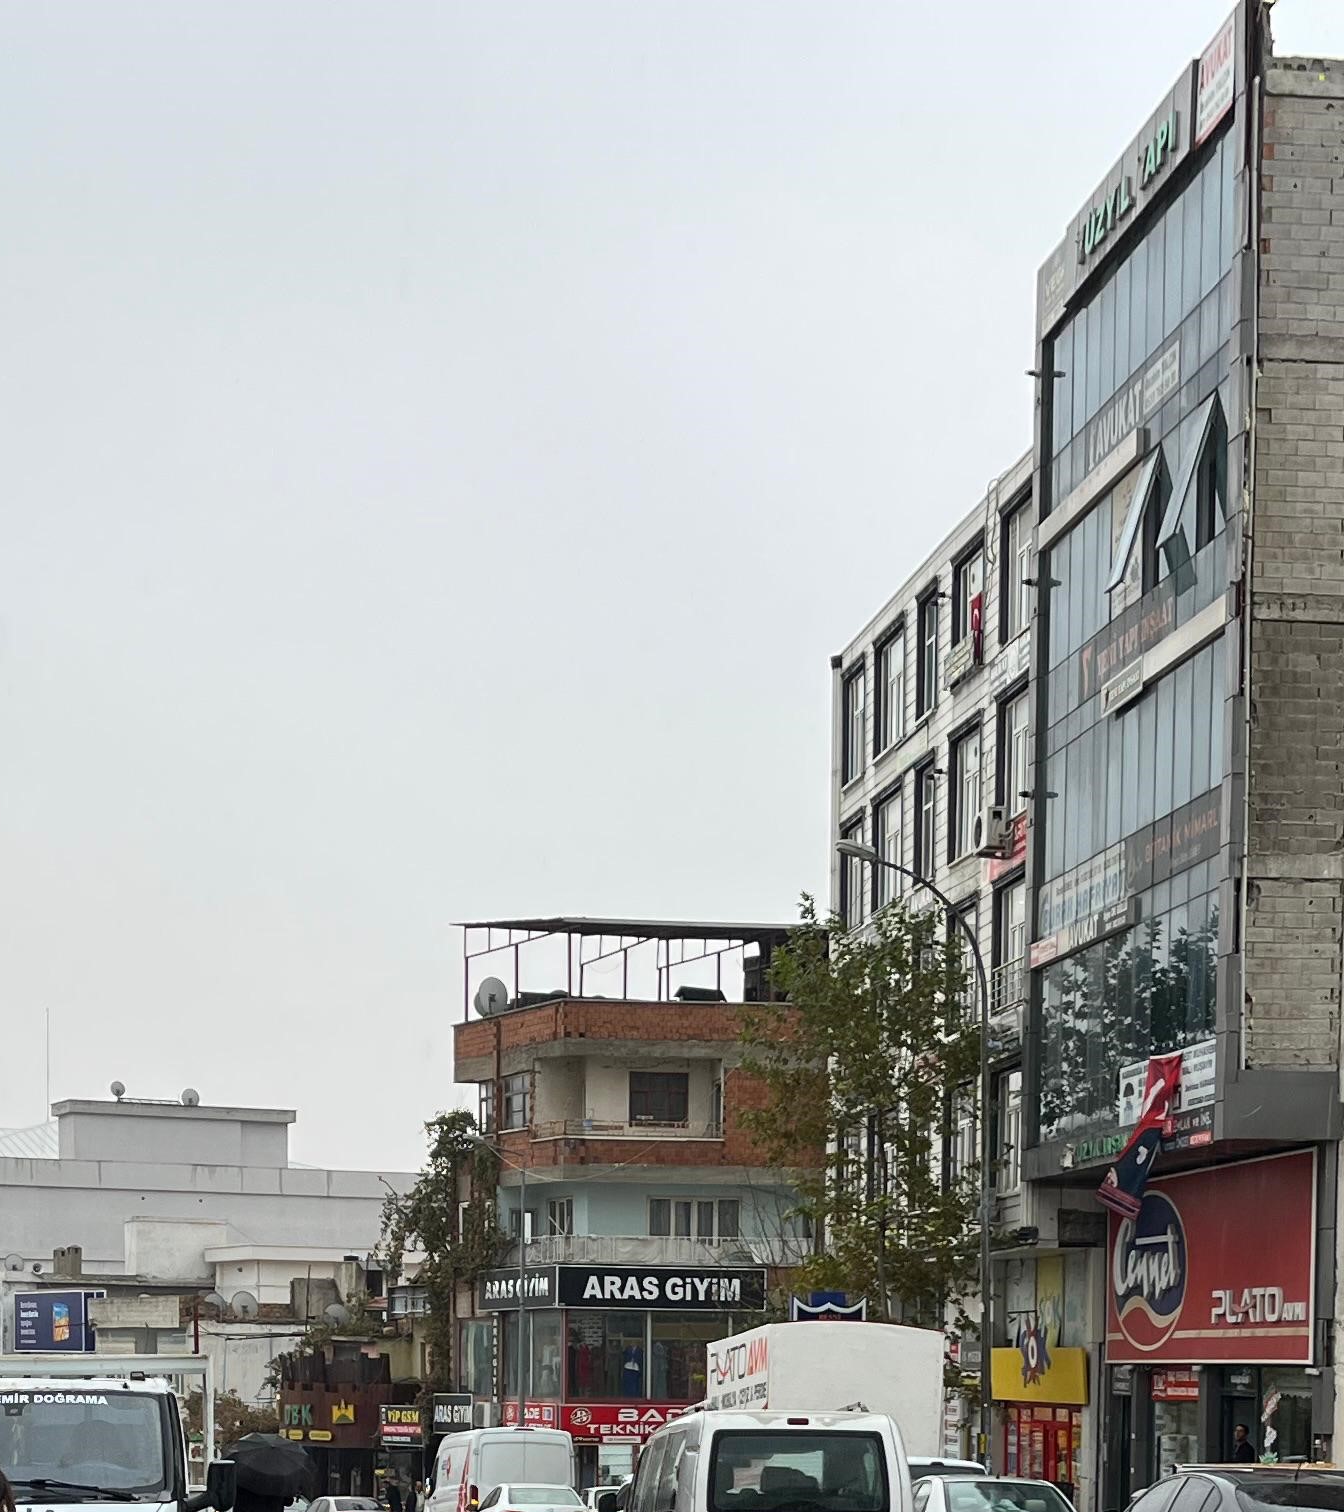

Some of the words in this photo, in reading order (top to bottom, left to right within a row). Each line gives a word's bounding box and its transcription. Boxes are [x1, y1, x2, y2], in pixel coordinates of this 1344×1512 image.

[1095, 378, 1143, 464] AVUKAT
[1068, 913, 1098, 951] AVUKAT
[1113, 1217, 1180, 1300] Cennet
[484, 1279, 514, 1299] ARAS
[582, 1275, 660, 1300] ARAS
[1210, 1286, 1280, 1325] PLATO
[1281, 1302, 1306, 1321] AVM
[747, 1336, 768, 1376] AVM
[33, 1392, 108, 1406] DOĞRAMA
[435, 1405, 452, 1423] ARAS
[586, 1421, 656, 1434] TEKNİK
